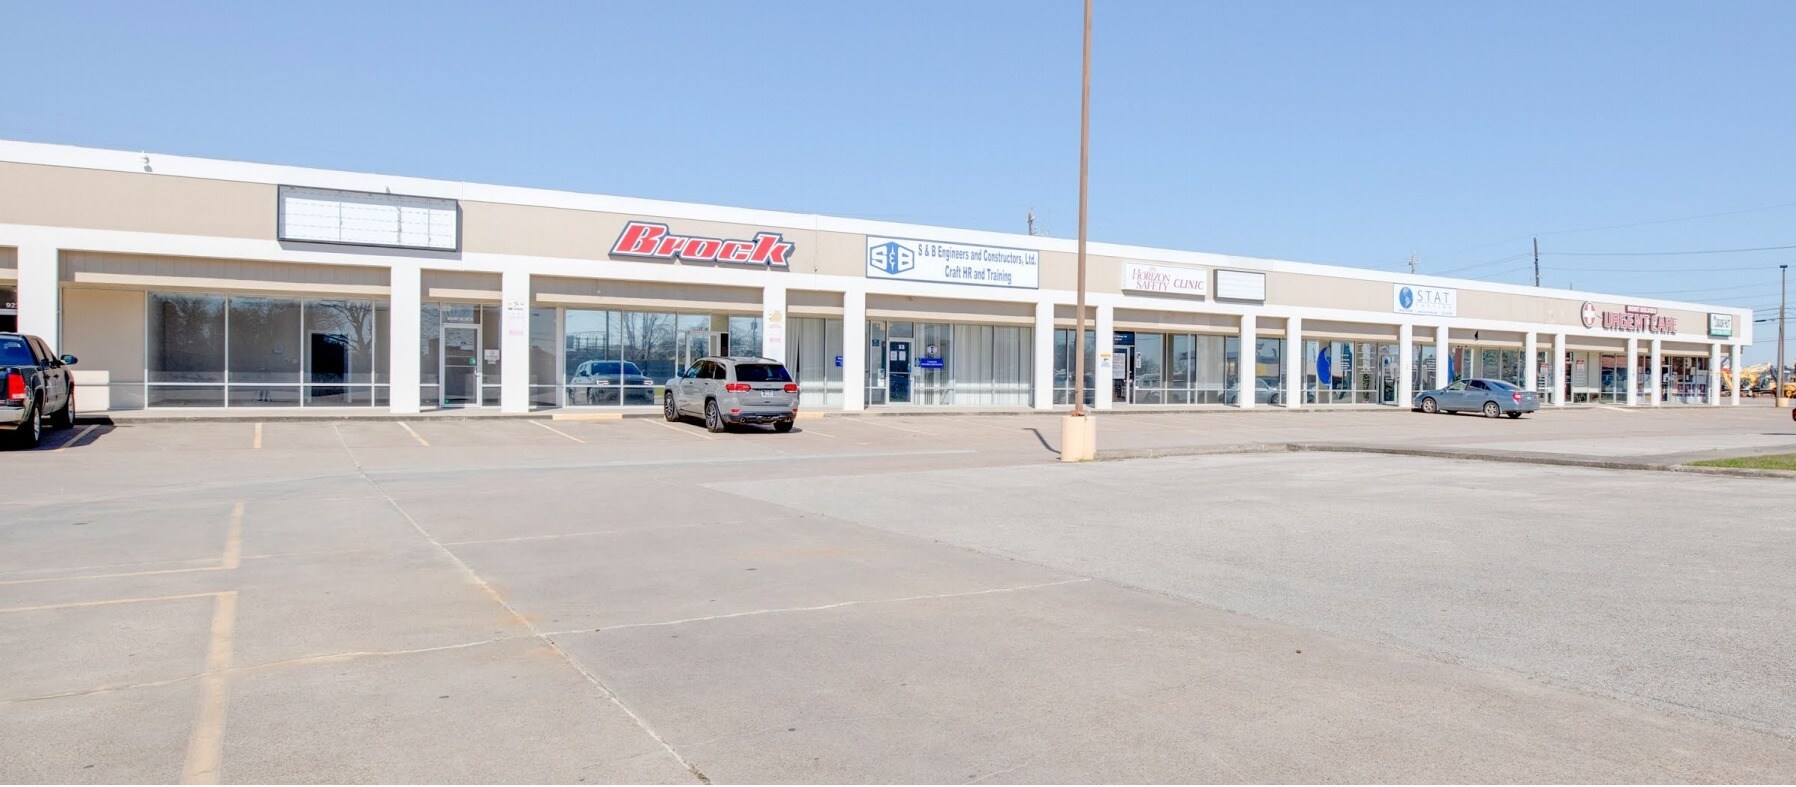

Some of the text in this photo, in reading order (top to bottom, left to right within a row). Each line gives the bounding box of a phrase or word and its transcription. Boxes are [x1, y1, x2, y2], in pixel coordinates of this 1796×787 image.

[611, 220, 793, 267] Brock
[918, 243, 1037, 266] S & B Engineers and Constructors, Ltd.
[945, 265, 1012, 285] Craft HR and Training
[1136, 278, 1204, 291] SAFETY CLINIC
[1417, 290, 1450, 303] STAT
[1602, 311, 1678, 335] URGENT CARE
